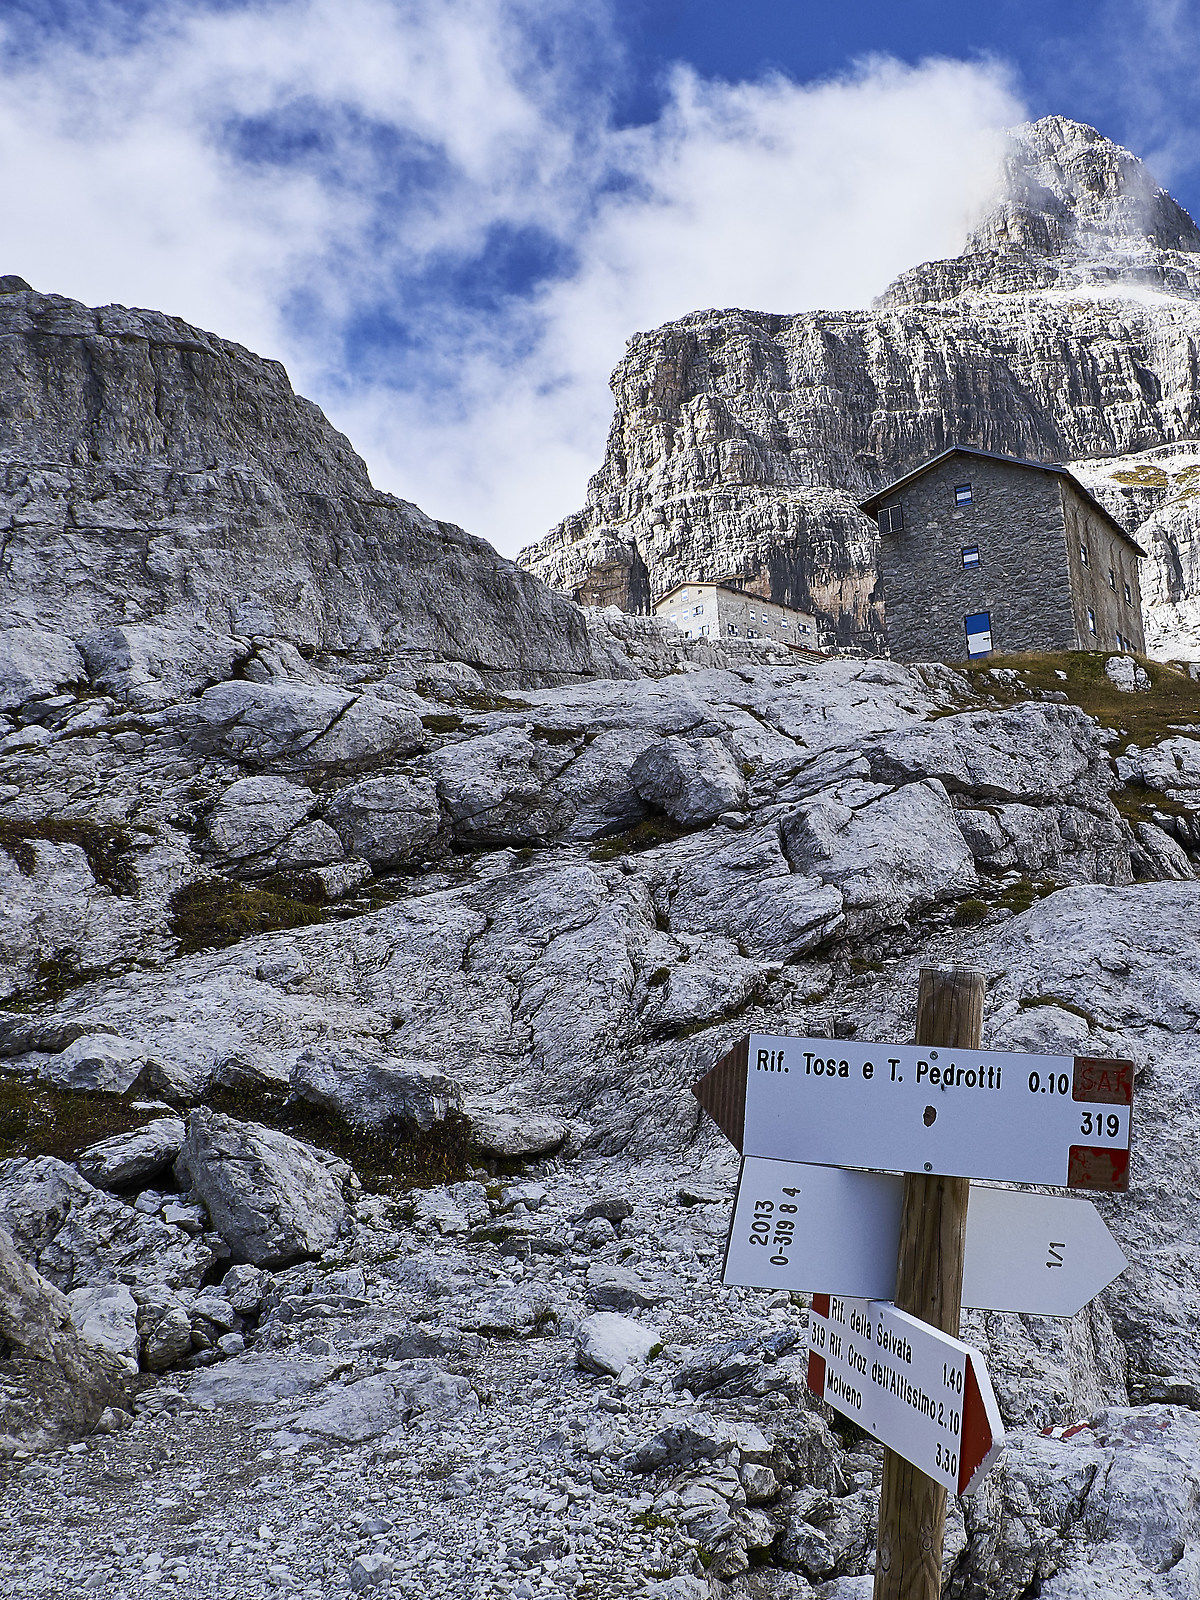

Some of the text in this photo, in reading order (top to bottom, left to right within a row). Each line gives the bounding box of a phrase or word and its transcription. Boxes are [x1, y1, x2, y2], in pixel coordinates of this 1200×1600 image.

[756, 1049, 1069, 1095] Rif. Tosa e T. Pedrotti 0.10
[1080, 1112, 1120, 1138] 319
[779, 1204, 798, 1214] 8
[782, 1187, 801, 1198] 4
[749, 1200, 775, 1246] 2013
[1045, 1242, 1065, 1268] 1/1
[831, 1296, 962, 1395] Rif. della Selvata 1.40
[811, 1321, 960, 1435] 319 Rif. Croz dell'Altissimo 2.10
[827, 1367, 957, 1477] Molveno 3.30
